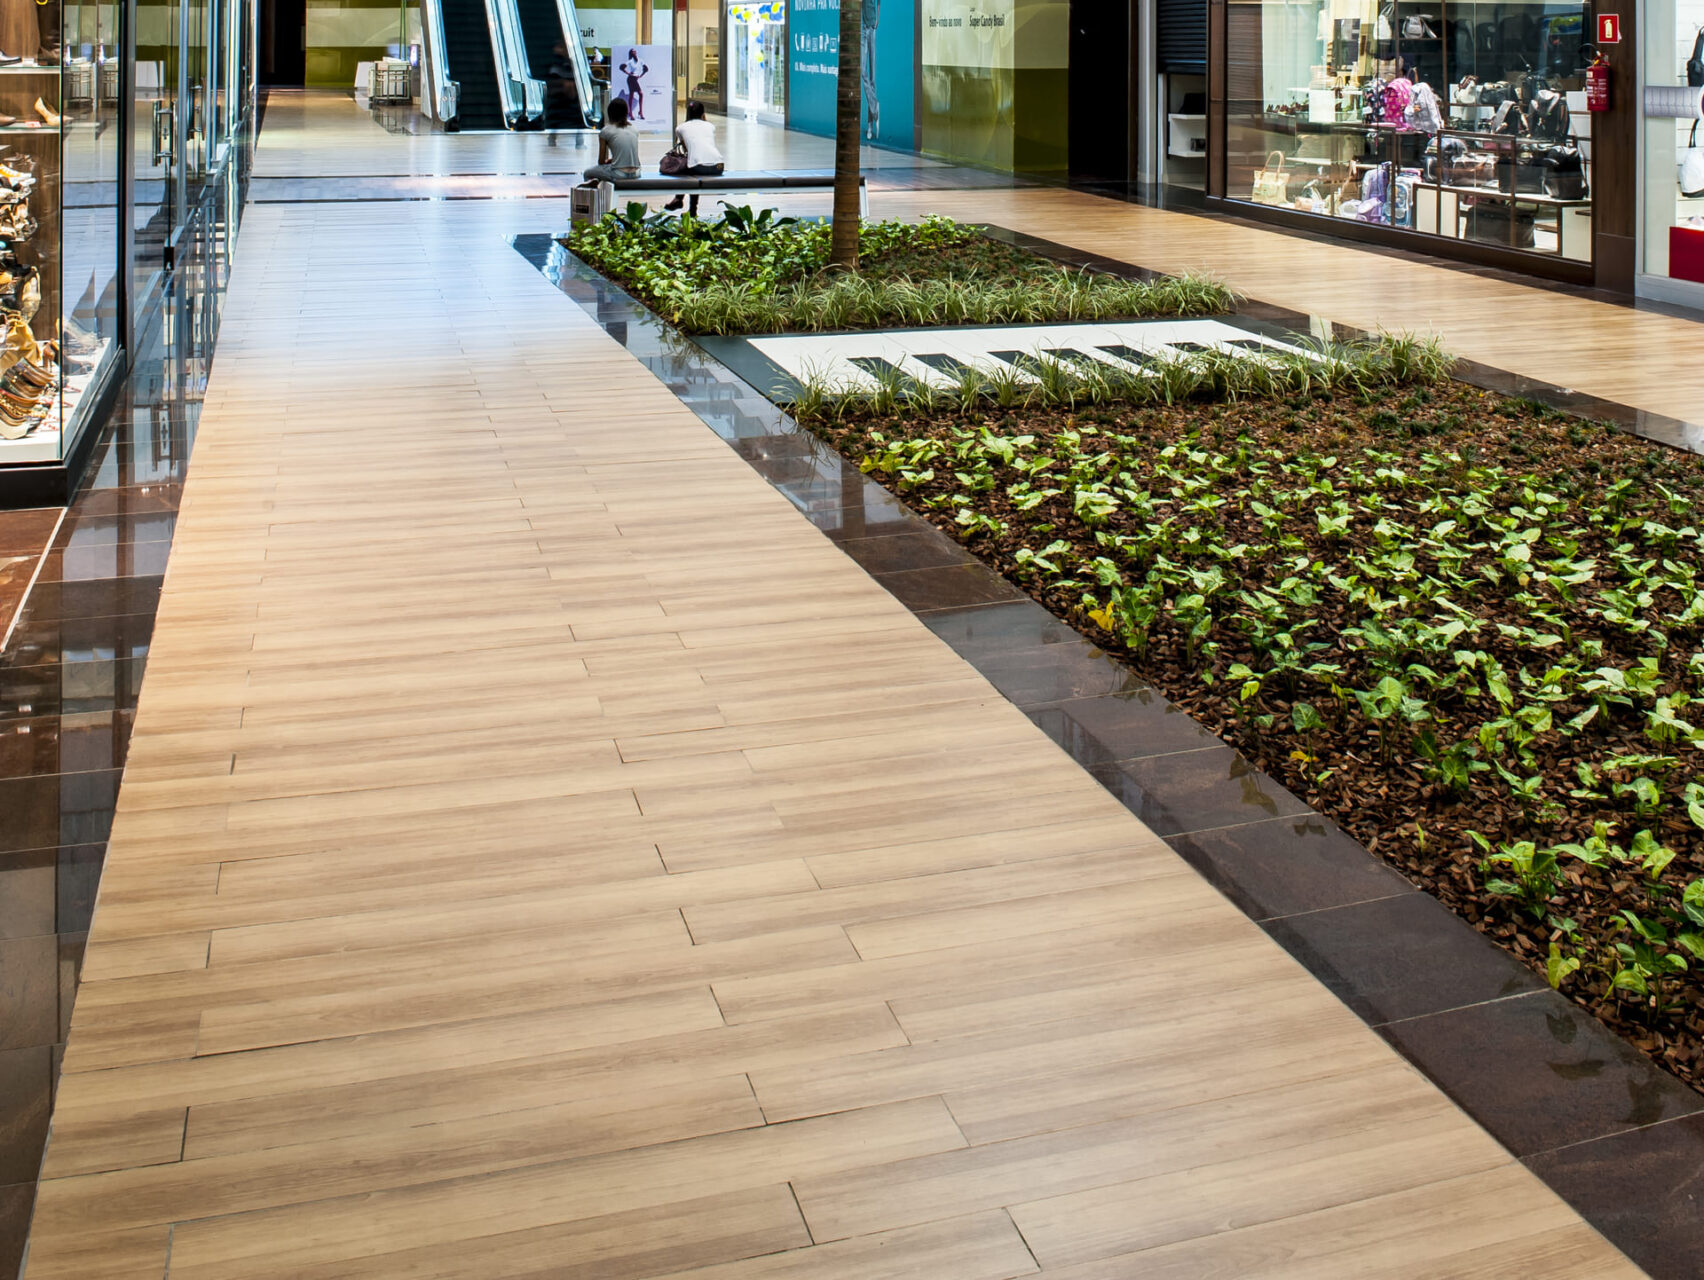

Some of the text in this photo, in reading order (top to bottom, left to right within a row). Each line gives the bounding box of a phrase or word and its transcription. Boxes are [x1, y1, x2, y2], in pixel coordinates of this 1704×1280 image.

[969, 14, 980, 29] Super
[981, 14, 992, 29] Candy
[993, 13, 1005, 27] Brasil
